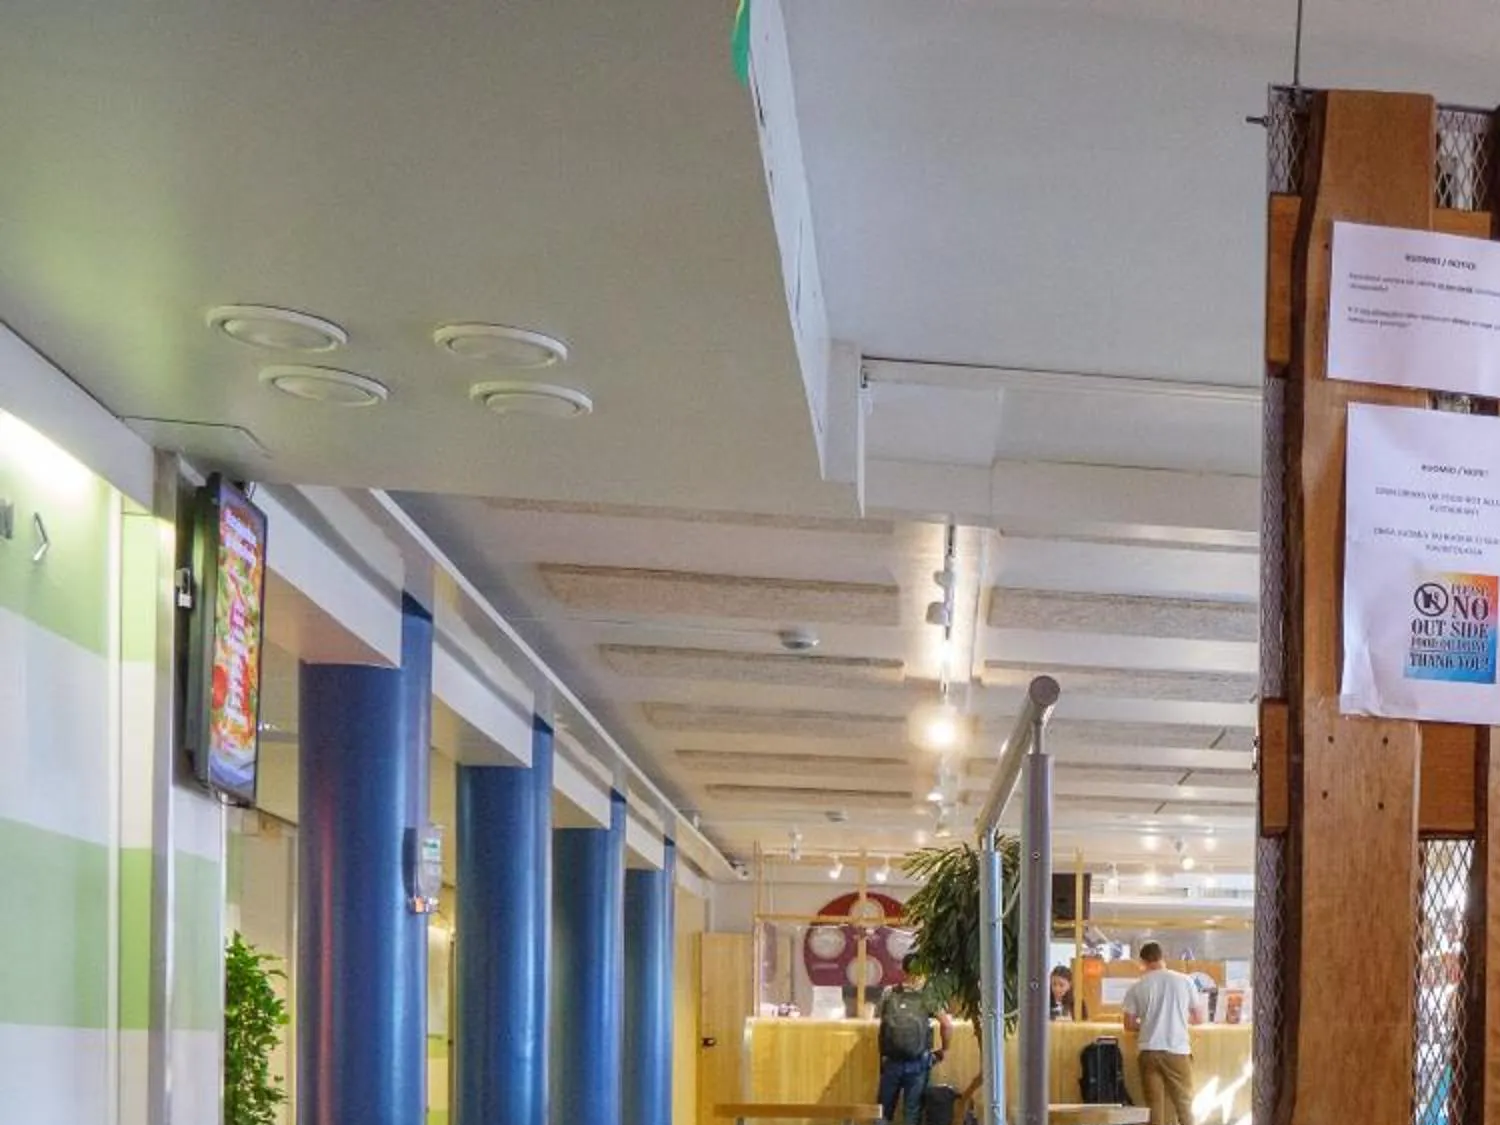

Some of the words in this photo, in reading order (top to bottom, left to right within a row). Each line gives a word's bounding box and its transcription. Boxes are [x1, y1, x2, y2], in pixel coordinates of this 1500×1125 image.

[1452, 595, 1489, 621] NO
[1411, 618, 1446, 636] OUT
[1450, 621, 1489, 639] SIDE
